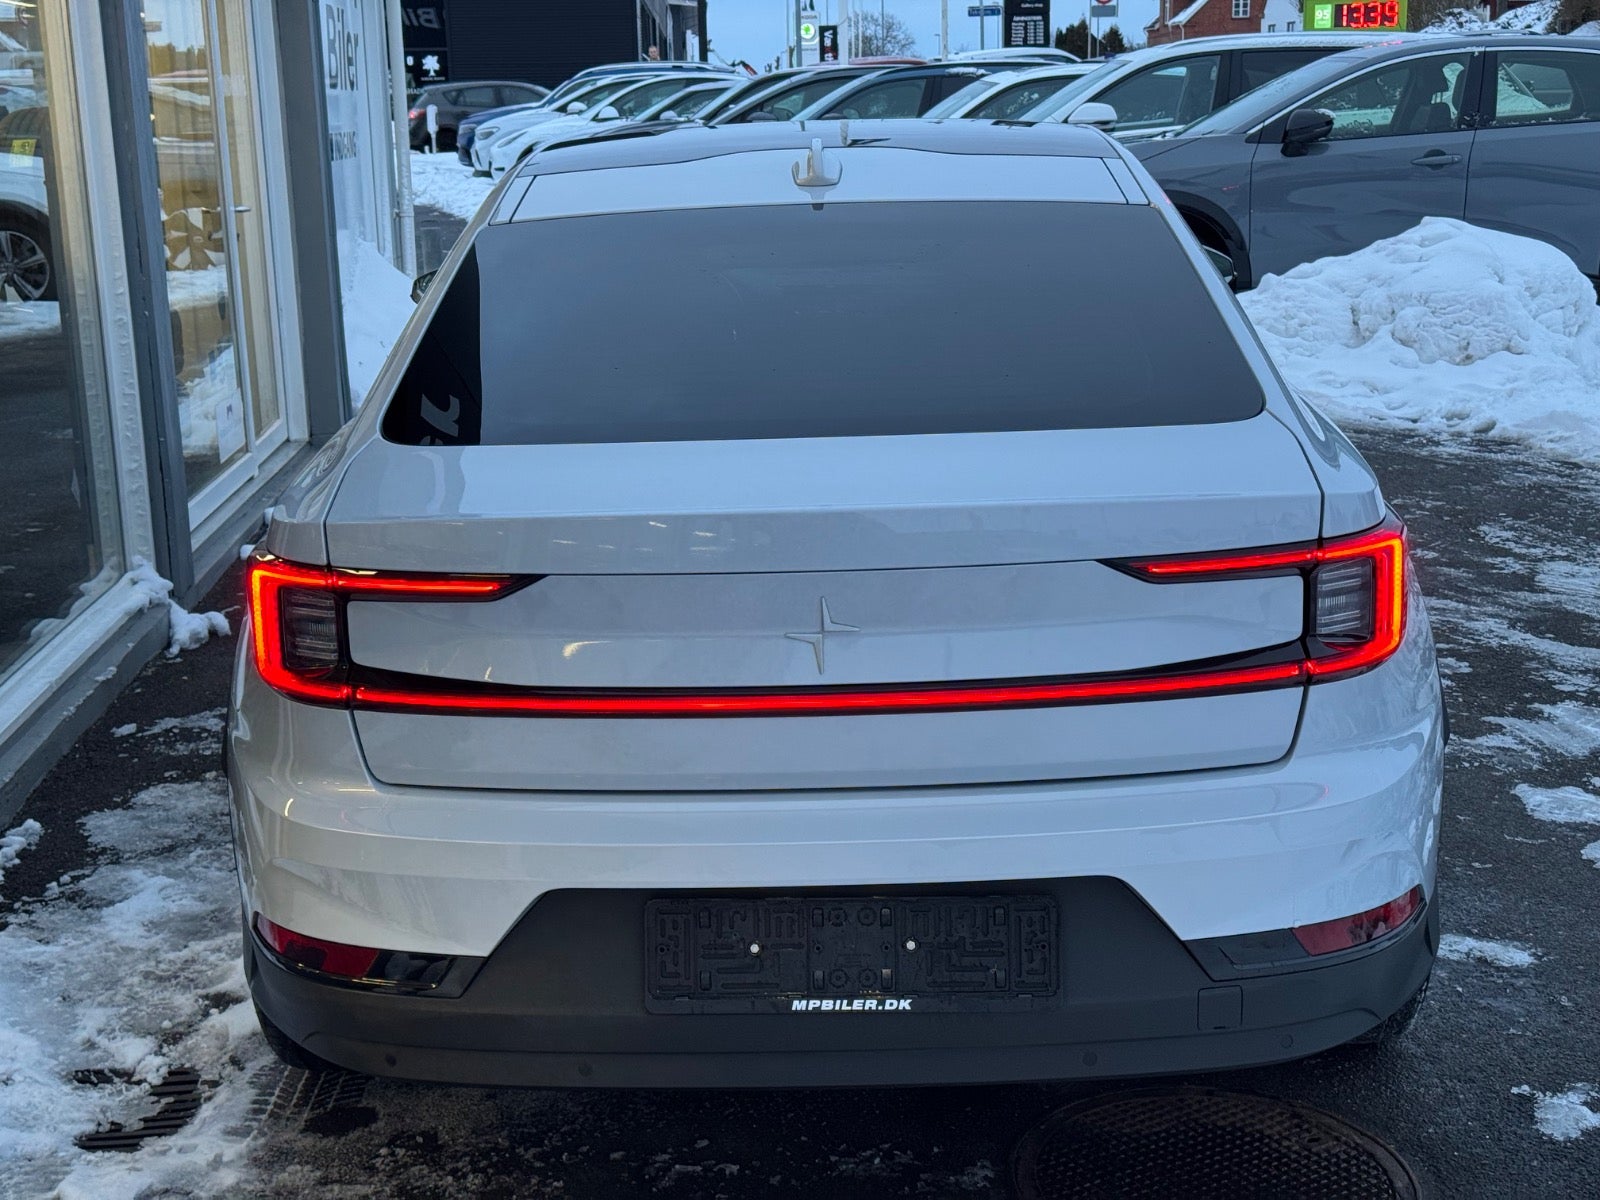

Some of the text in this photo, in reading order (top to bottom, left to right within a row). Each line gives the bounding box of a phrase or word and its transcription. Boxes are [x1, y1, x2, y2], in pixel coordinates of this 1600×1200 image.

[1316, 9, 1330, 20] 95
[1342, 1, 1398, 28] 13.39
[326, 4, 359, 91] Biler
[791, 999, 913, 1011] MPBILER.DK
